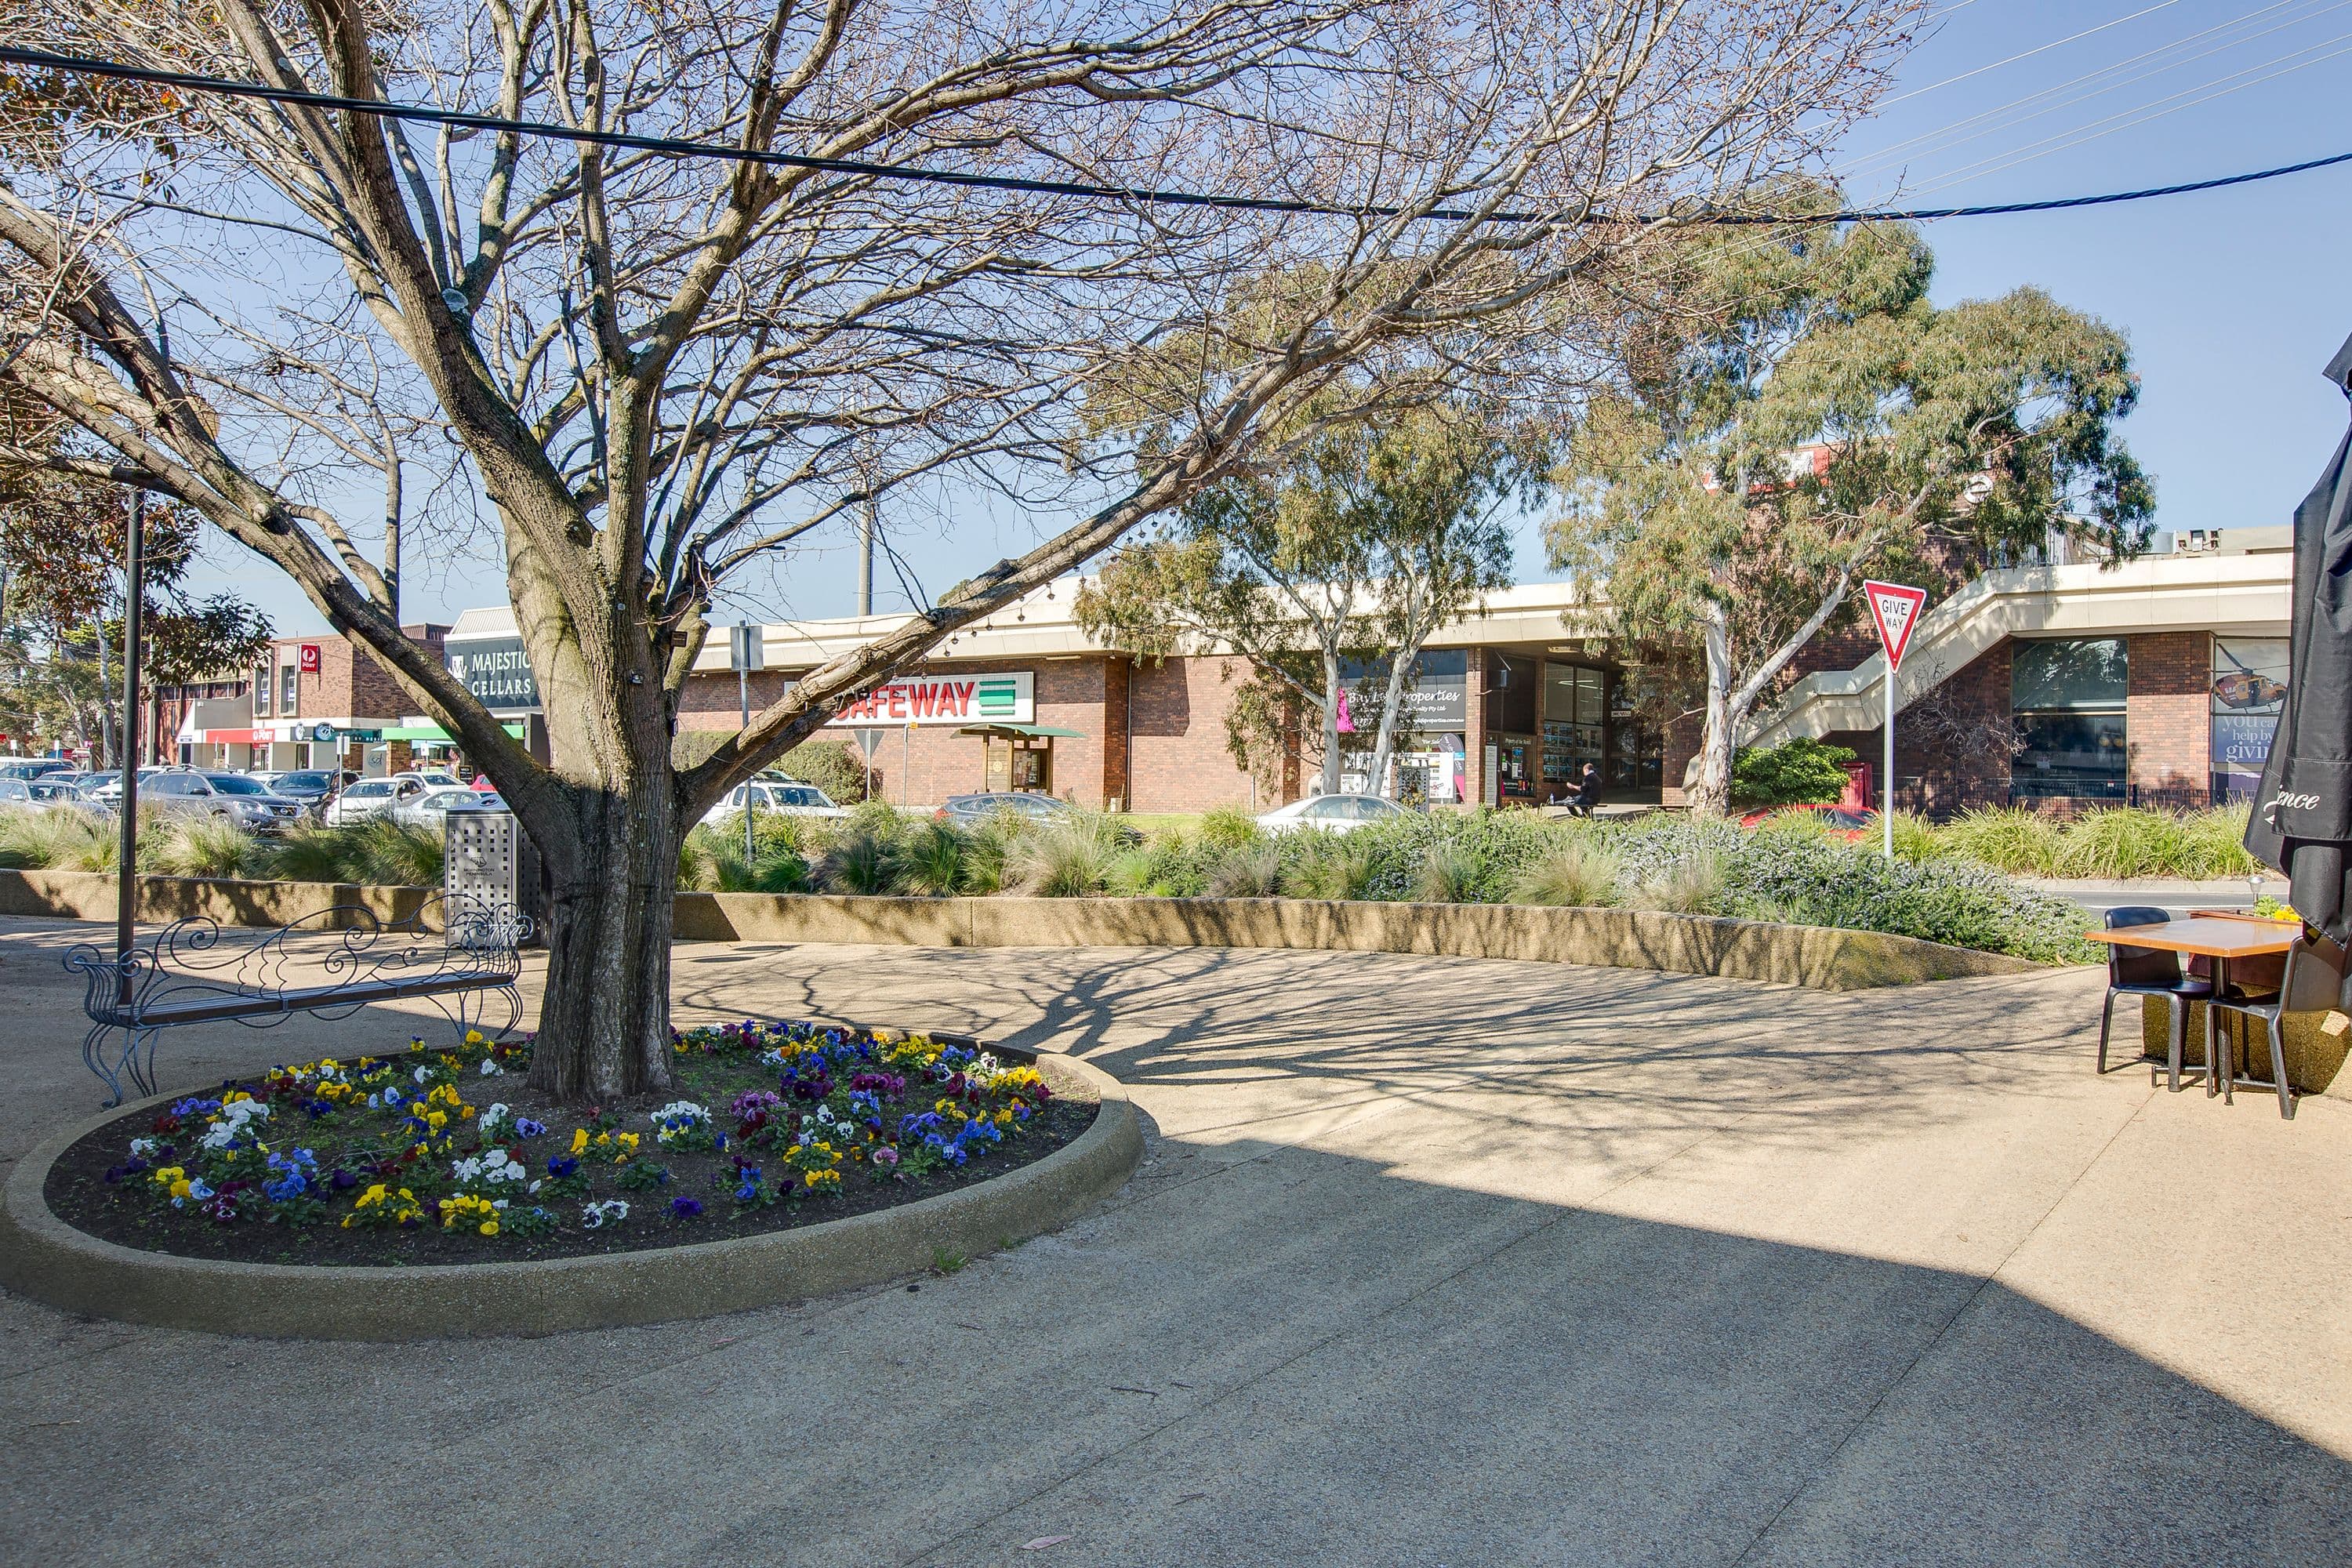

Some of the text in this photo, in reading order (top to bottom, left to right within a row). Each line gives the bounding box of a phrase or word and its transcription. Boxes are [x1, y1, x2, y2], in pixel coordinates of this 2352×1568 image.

[1882, 599, 1907, 615] GIVE
[1886, 617, 1904, 630] WAY
[472, 651, 531, 675] MAJESTIC
[472, 678, 531, 696] CELLARS
[2223, 716, 2259, 731] you
[2232, 729, 2273, 742] help by
